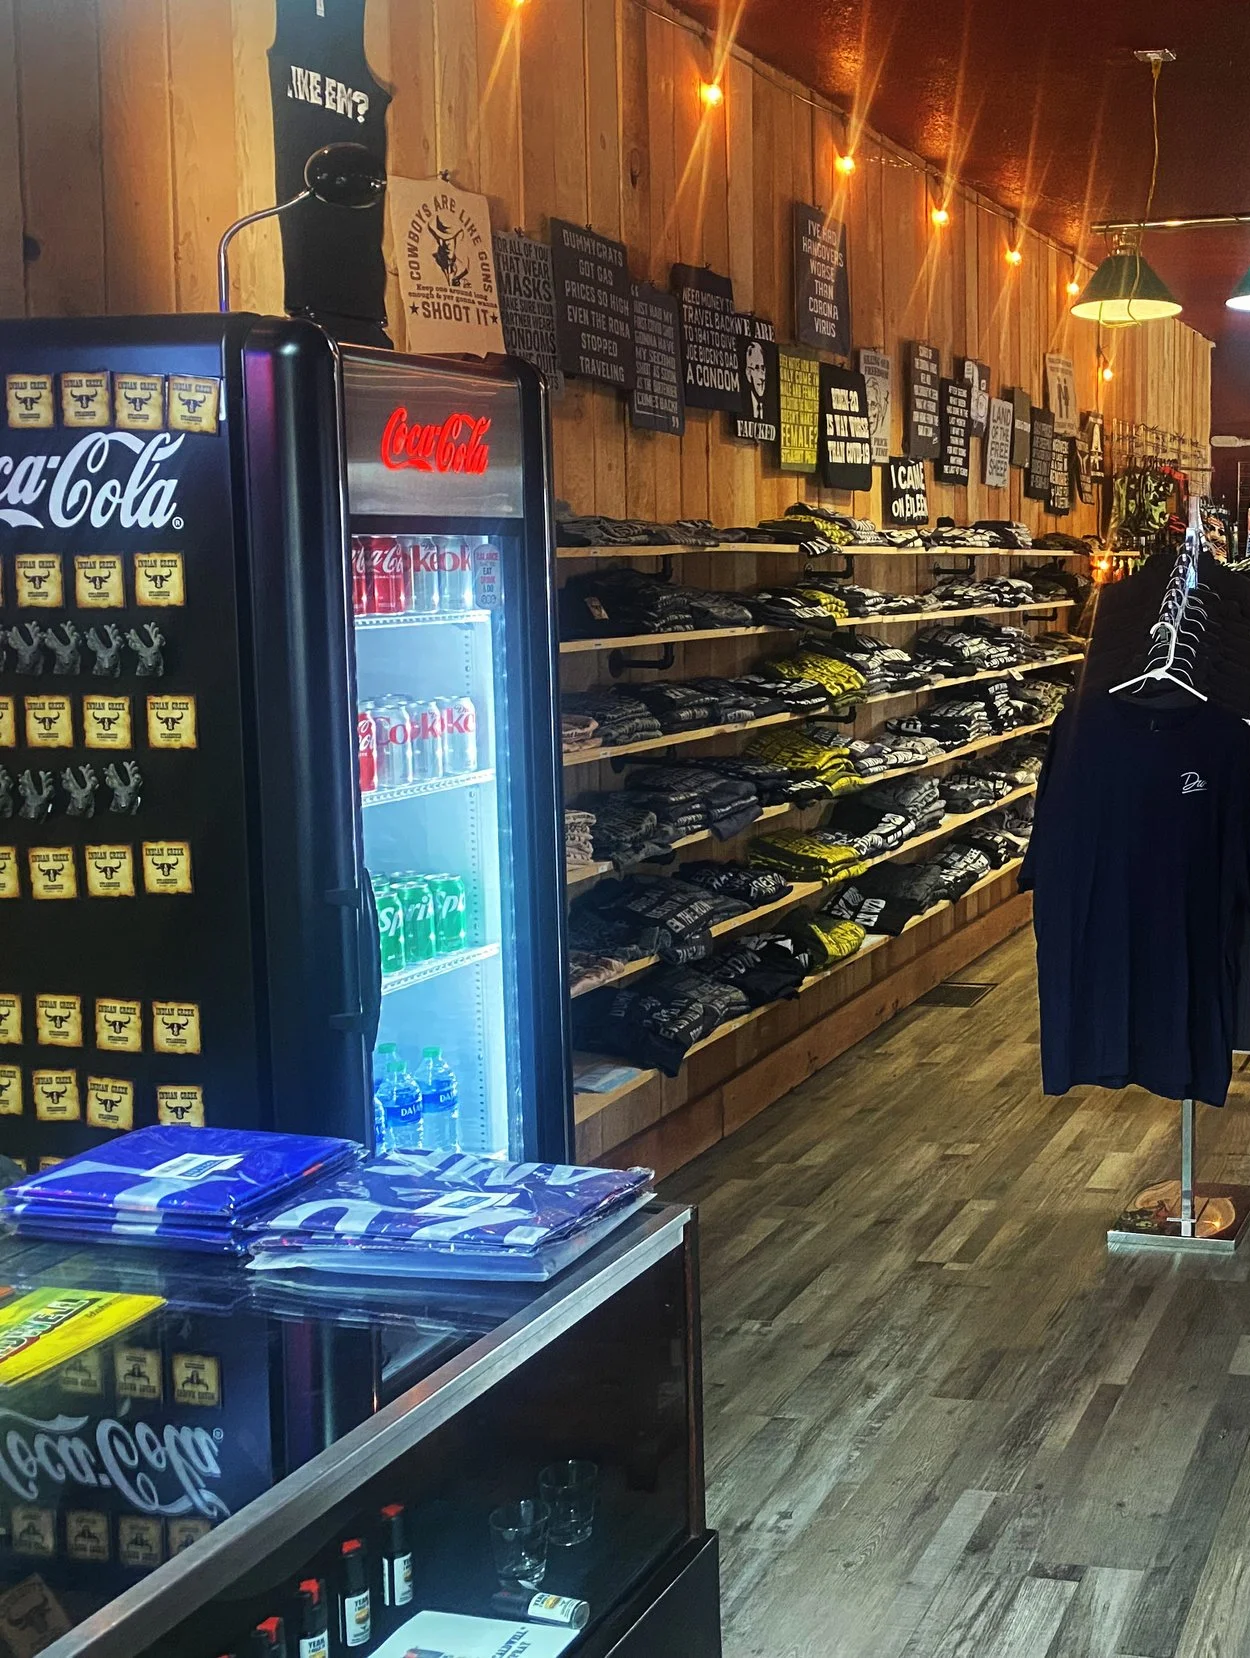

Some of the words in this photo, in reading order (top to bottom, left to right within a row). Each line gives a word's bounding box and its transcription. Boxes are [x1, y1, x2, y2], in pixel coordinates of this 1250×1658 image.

[287, 66, 322, 105] IKE
[808, 219, 821, 239] I'VE
[407, 203, 432, 281] COWBOYS
[433, 194, 456, 213] ARE
[459, 209, 482, 246] LIKE
[478, 251, 493, 293] GUNS
[509, 239, 523, 256] ALL
[533, 245, 549, 262] YOU
[562, 229, 624, 268] DUMMYCRATS
[802, 236, 844, 268] HANGOVERS
[521, 258, 550, 280] WEAR
[578, 259, 595, 277] GOT
[597, 266, 614, 286] GAS
[809, 259, 835, 282] WORSE
[564, 280, 596, 303] PRICES
[597, 288, 609, 308] SO
[610, 294, 630, 317] HIGH
[682, 287, 700, 306] NEED
[701, 292, 724, 311] MONEY
[814, 279, 834, 300] THAN
[422, 301, 471, 323] SHOOT
[476, 308, 489, 326] IT
[567, 305, 590, 326] EVEN
[591, 311, 607, 331] THE
[682, 305, 714, 328] TRAVEL
[715, 313, 736, 333] BACK
[808, 297, 839, 320] CORONA
[684, 325, 694, 342] TO
[711, 331, 720, 347] TO
[721, 334, 737, 352] GIVE
[735, 317, 751, 337] WE
[754, 322, 775, 342] ARE
[814, 317, 836, 338] VIRUS
[580, 332, 618, 357] STOPPED
[686, 344, 698, 362] JOE
[725, 352, 739, 370] DAD
[579, 356, 625, 383] TRAVELING
[686, 363, 695, 384] A
[696, 364, 741, 392] CONDOM
[992, 404, 1012, 426] LAND
[381, 406, 492, 475] Coca-Cola
[0, 432, 186, 530] ca-Cola
[890, 464, 897, 489] I
[897, 462, 926, 491] CAME
[892, 498, 905, 518] ON
[905, 493, 929, 520] EILEEN
